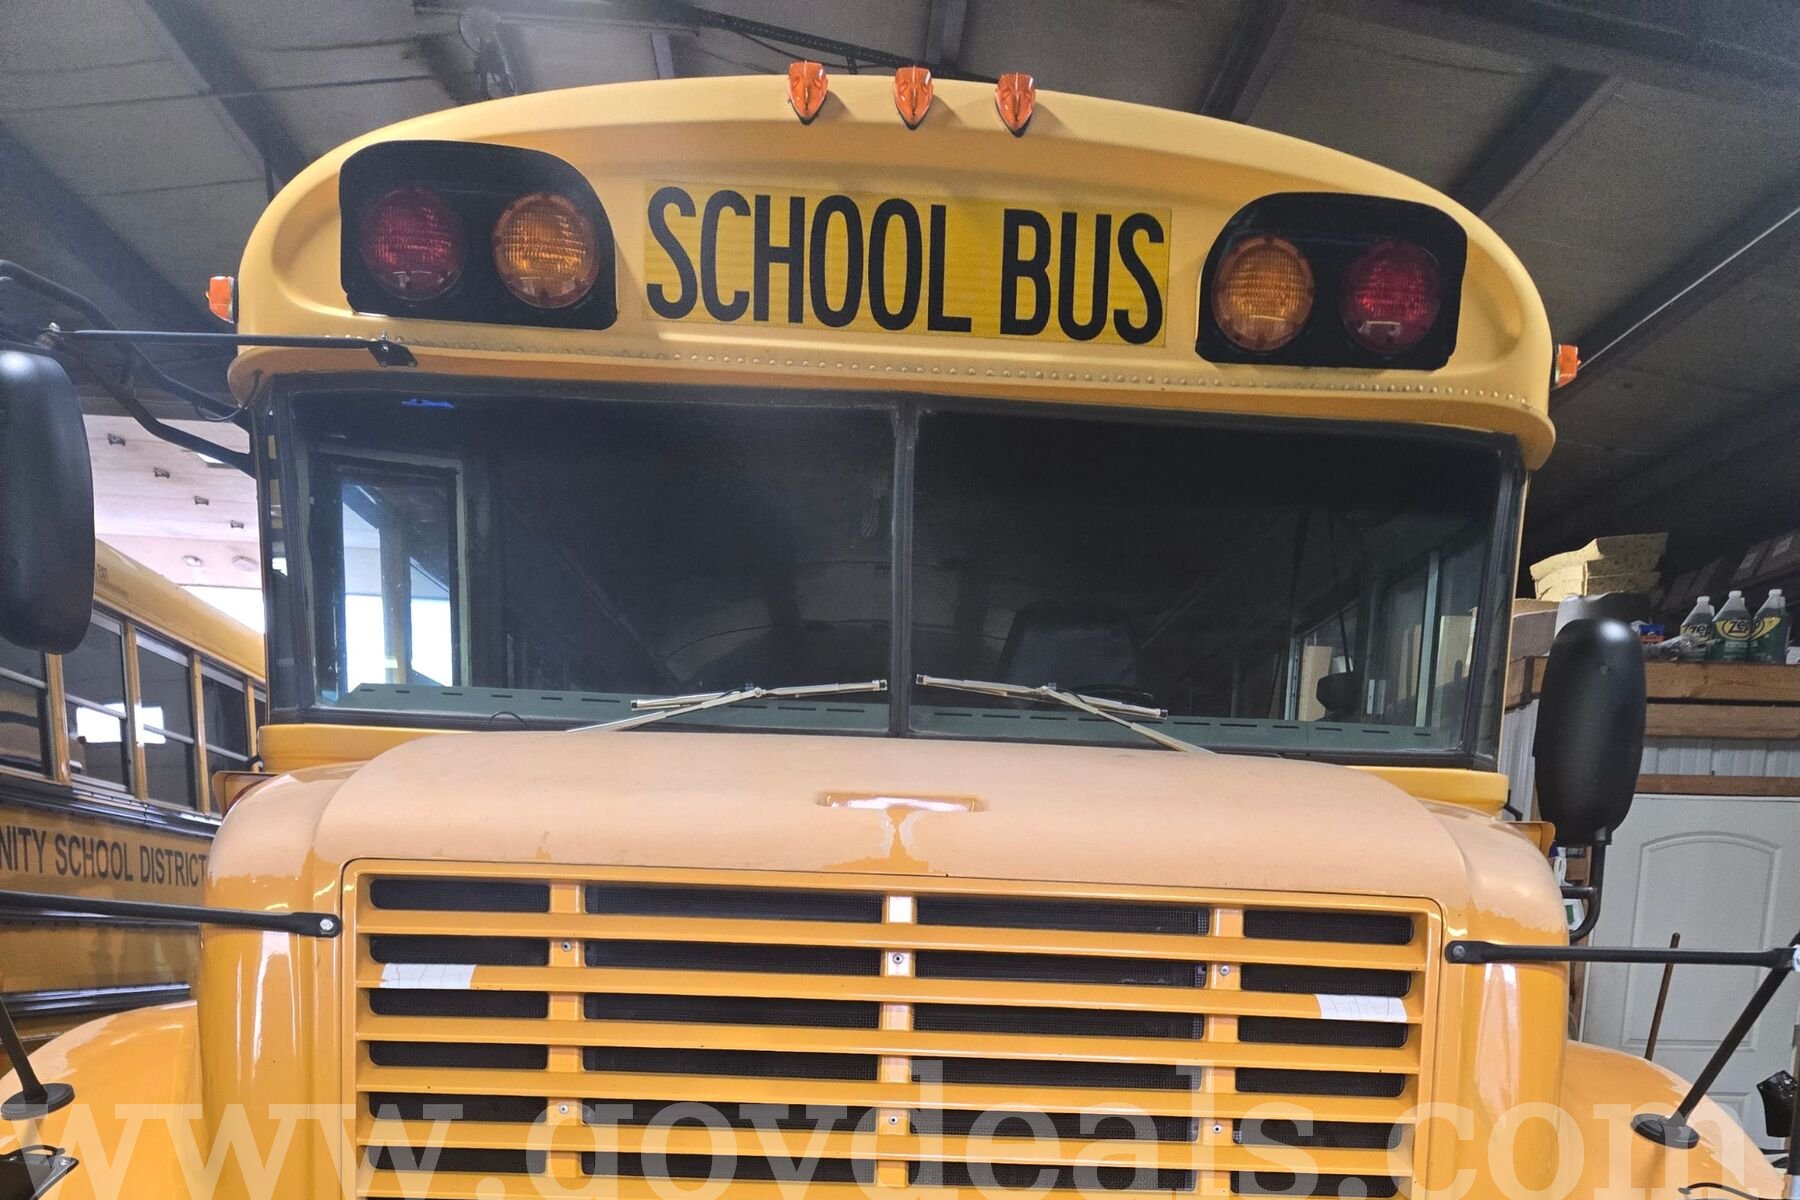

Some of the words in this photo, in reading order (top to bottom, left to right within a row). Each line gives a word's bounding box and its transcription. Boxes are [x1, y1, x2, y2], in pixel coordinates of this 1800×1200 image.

[646, 186, 972, 333] SCHOOL
[999, 208, 1165, 345] BUS
[55, 833, 133, 881] SCHOOL
[140, 845, 209, 888] DISTRICT
